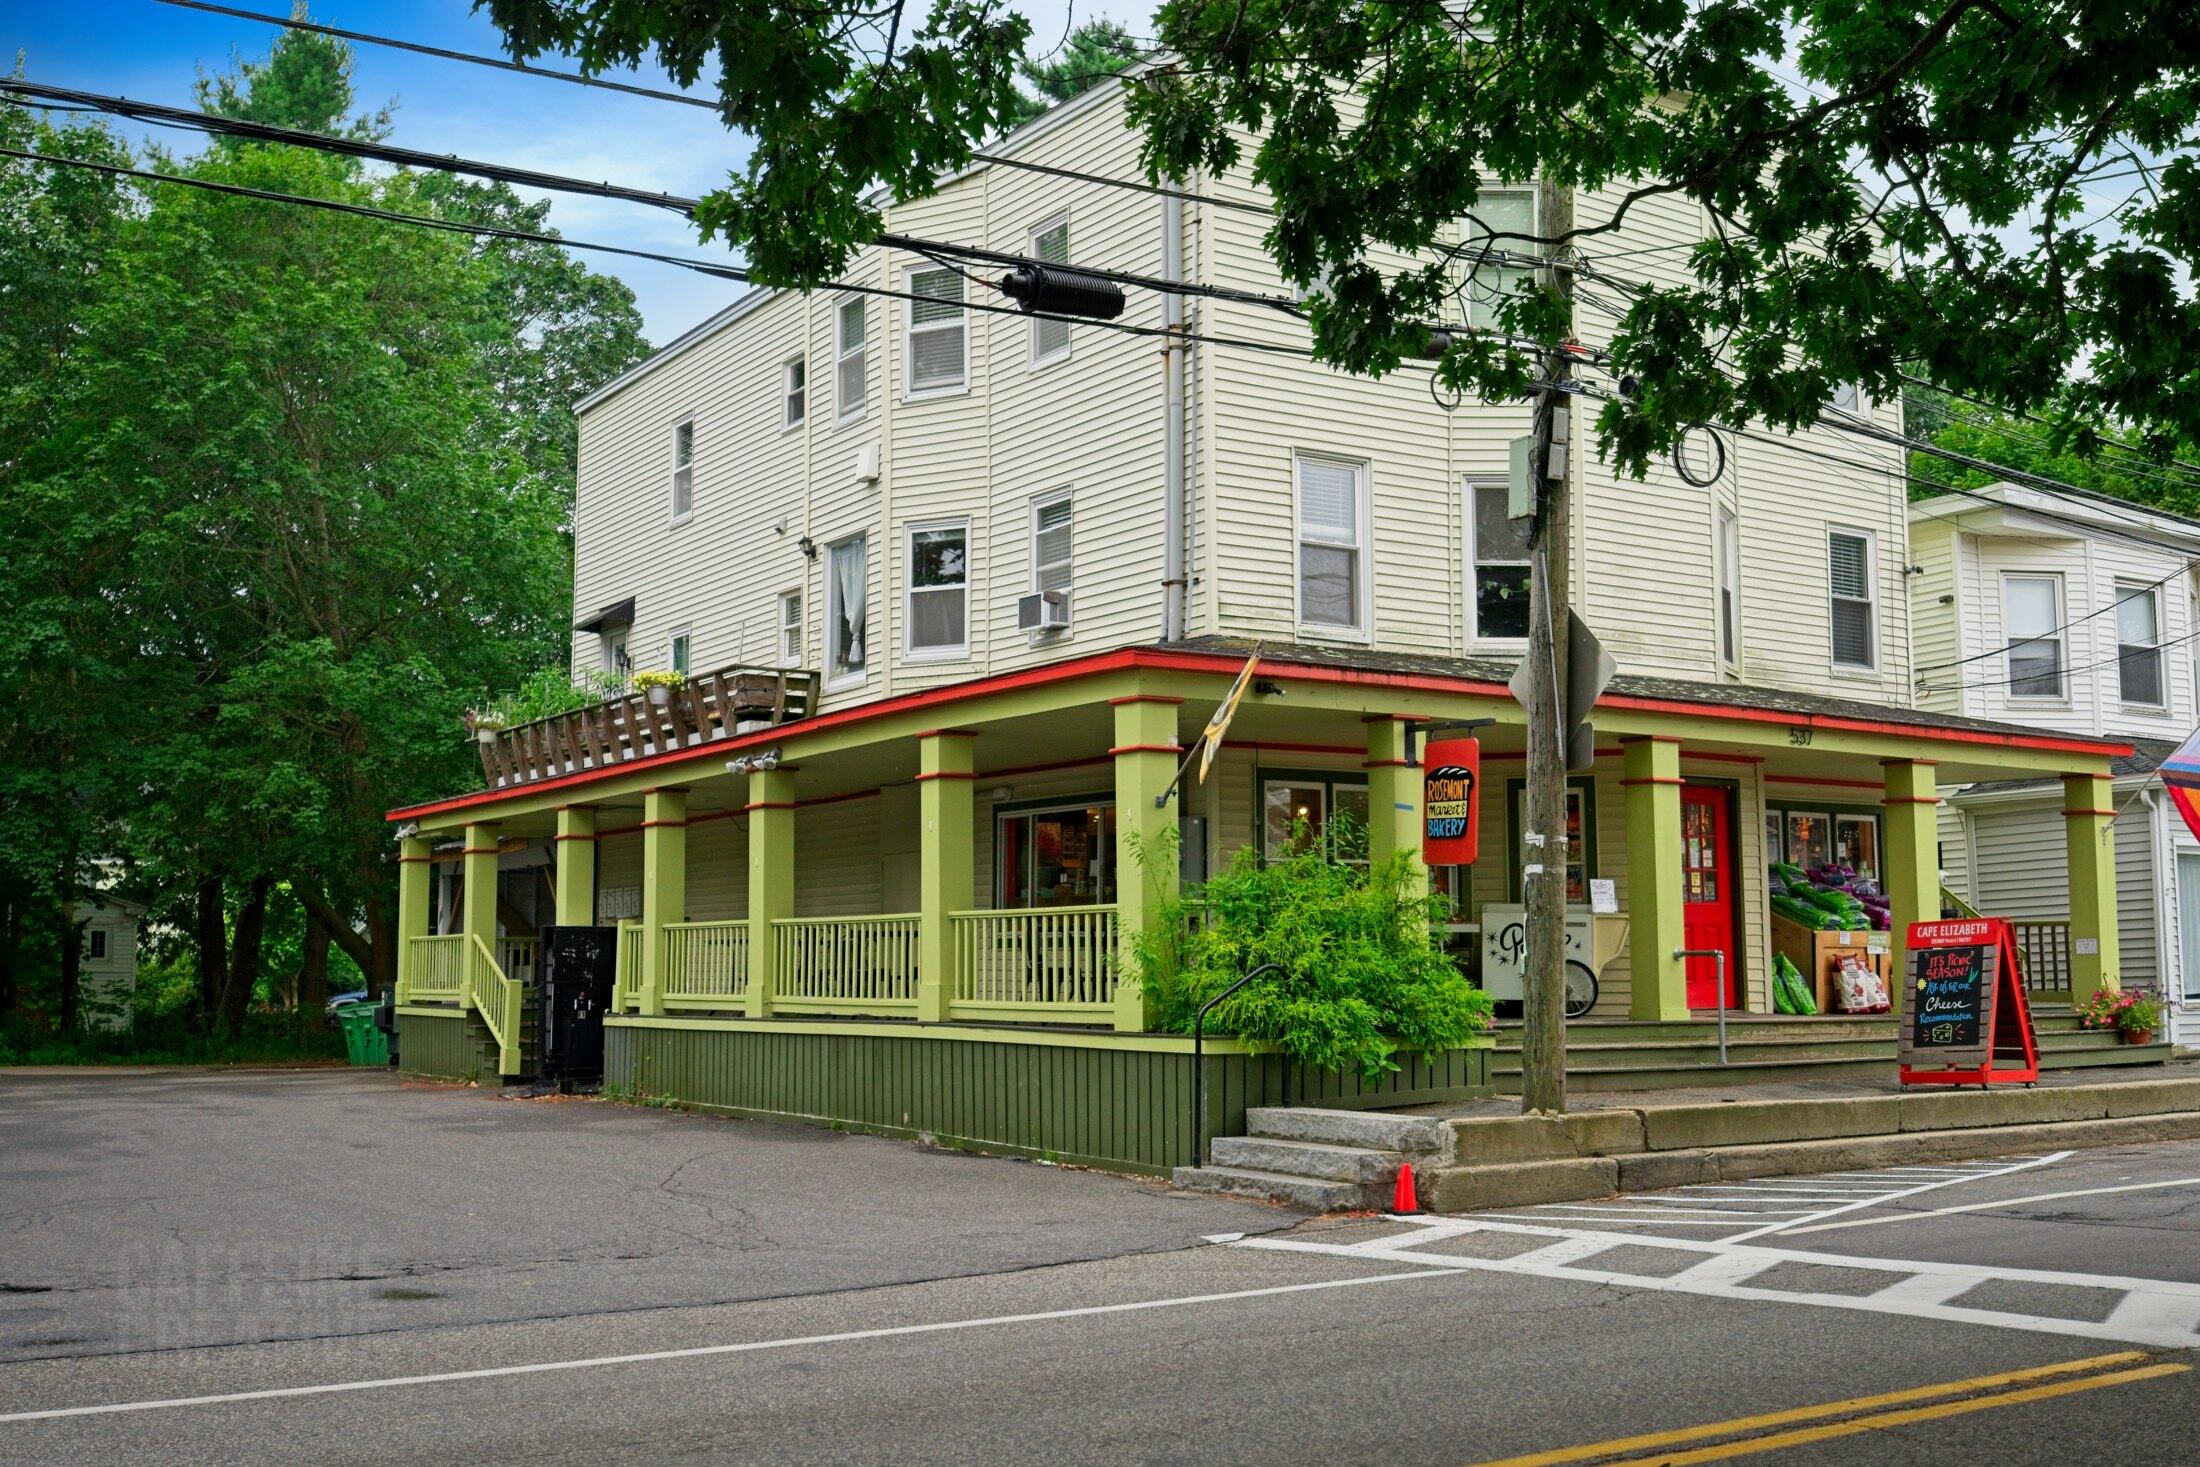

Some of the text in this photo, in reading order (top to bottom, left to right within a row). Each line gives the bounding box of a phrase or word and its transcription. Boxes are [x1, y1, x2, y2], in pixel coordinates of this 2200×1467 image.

[1789, 727, 1813, 746] 537
[1428, 779, 1470, 801] ROSEMONT
[1428, 819, 1466, 837] BAKERY
[1917, 922, 1988, 938] CAPE ELIZABETH
[1926, 966, 1969, 980] SEASON!
[1926, 997, 1972, 1012] Cheese
